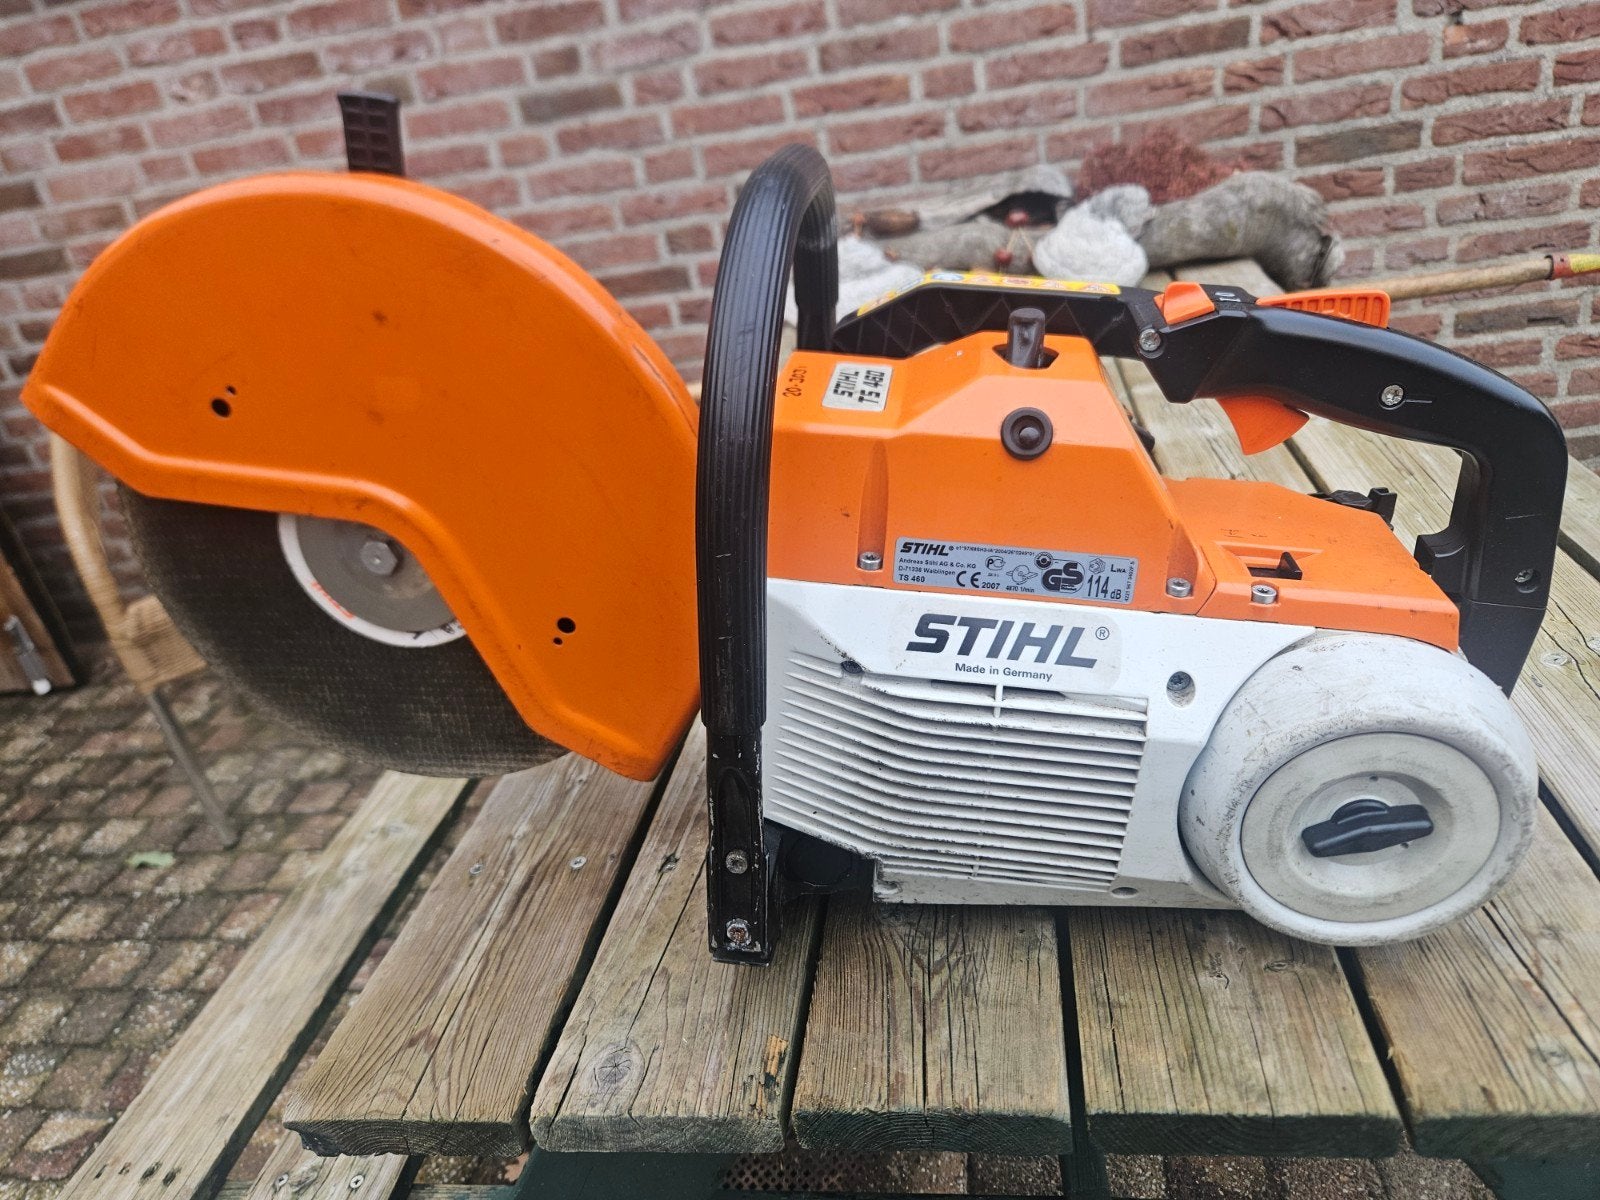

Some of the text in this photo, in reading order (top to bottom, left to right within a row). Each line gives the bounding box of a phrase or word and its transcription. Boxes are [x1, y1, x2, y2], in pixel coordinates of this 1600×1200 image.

[833, 371, 860, 398] STIHL
[858, 370, 885, 403] TS 460
[900, 541, 950, 556] STIHL
[899, 557, 923, 565] Andreas
[899, 573, 925, 583] TS 460
[923, 567, 956, 576] Waiblingen
[1042, 562, 1084, 591] GS
[981, 581, 1001, 590] 2007
[1087, 574, 1122, 600] 114 dB
[905, 612, 1098, 669] STIHL
[954, 662, 1053, 682] Made in Germany
